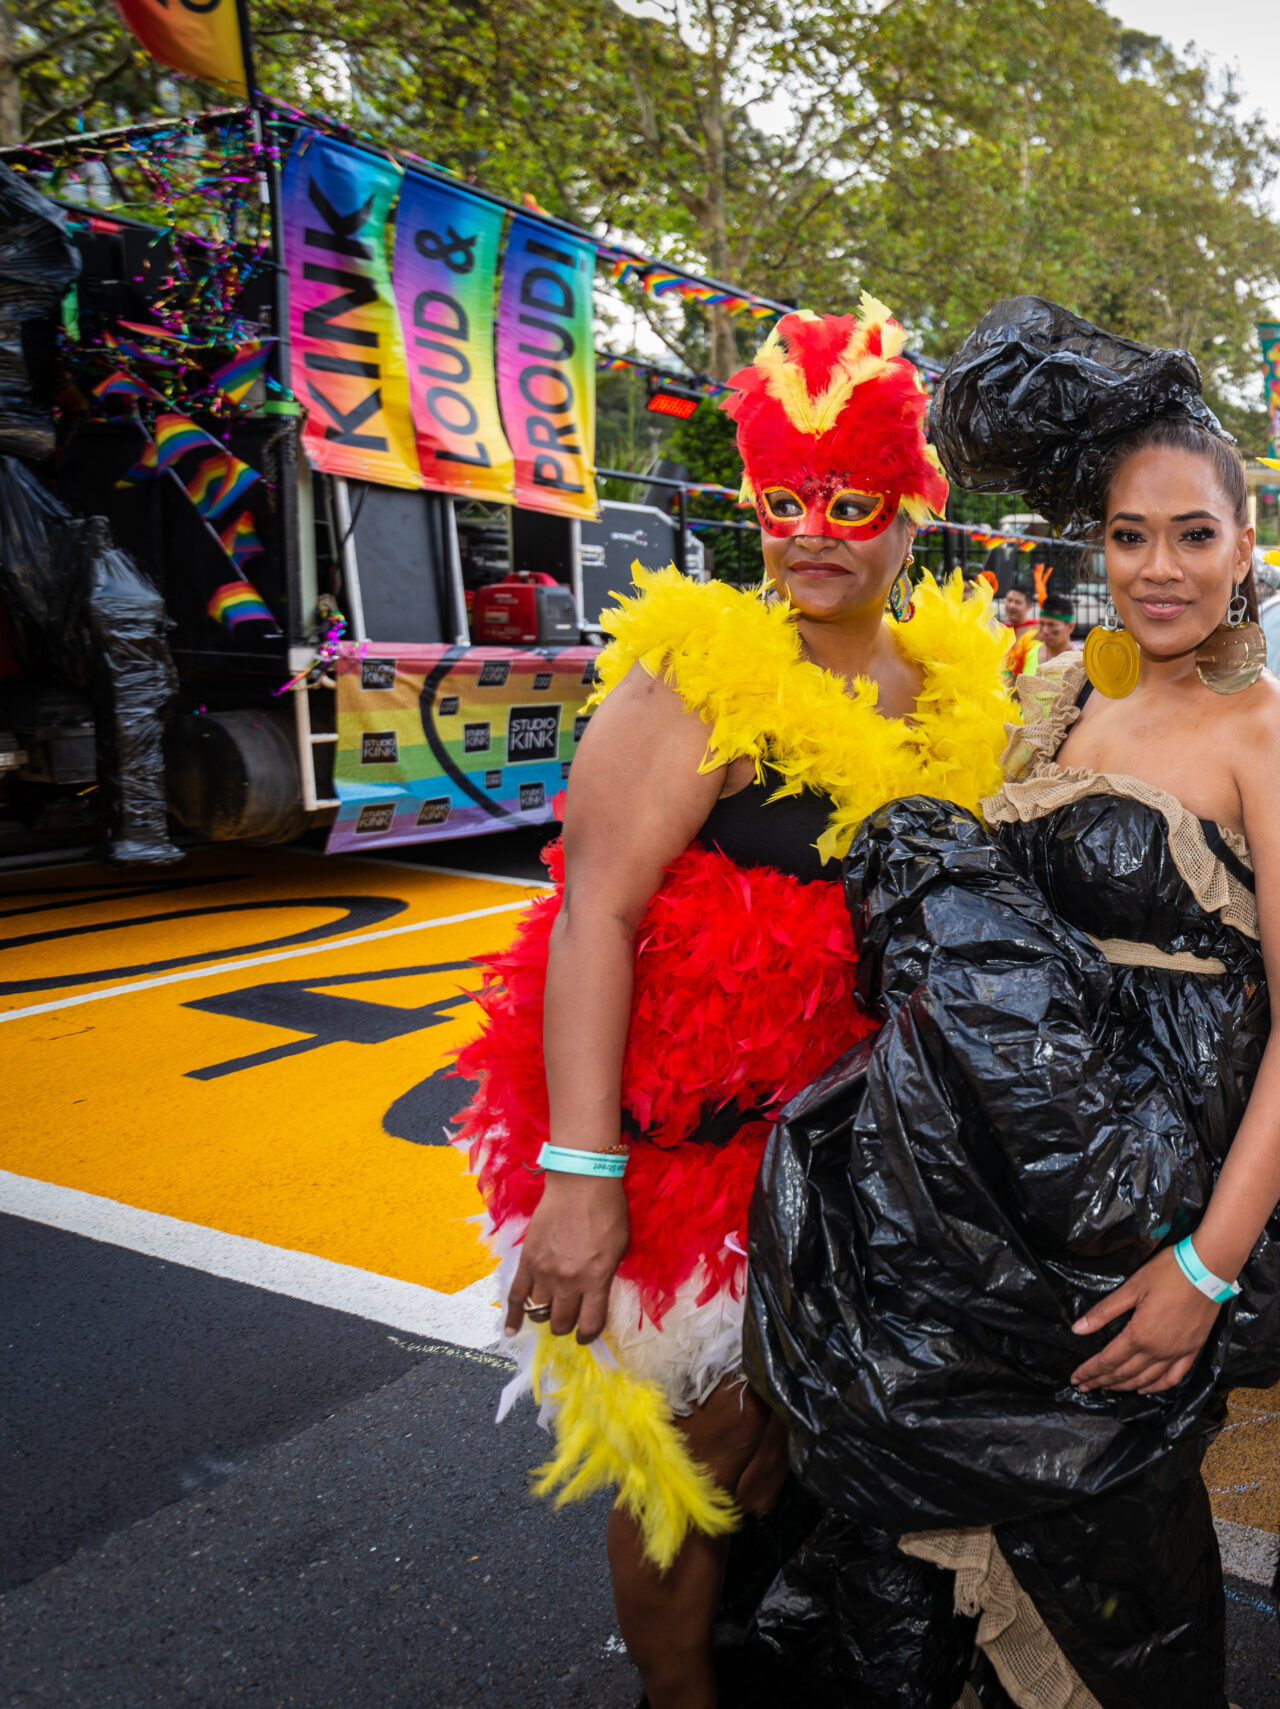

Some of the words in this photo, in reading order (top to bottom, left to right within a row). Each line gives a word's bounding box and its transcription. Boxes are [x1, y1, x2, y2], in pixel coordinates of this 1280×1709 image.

[414, 225, 478, 275] &
[303, 175, 390, 452] KINK
[413, 290, 491, 468] LOUD
[511, 717, 556, 732] STUDIO
[511, 730, 554, 750] KINK
[364, 745, 397, 758] KINK
[359, 816, 390, 828] KINK
